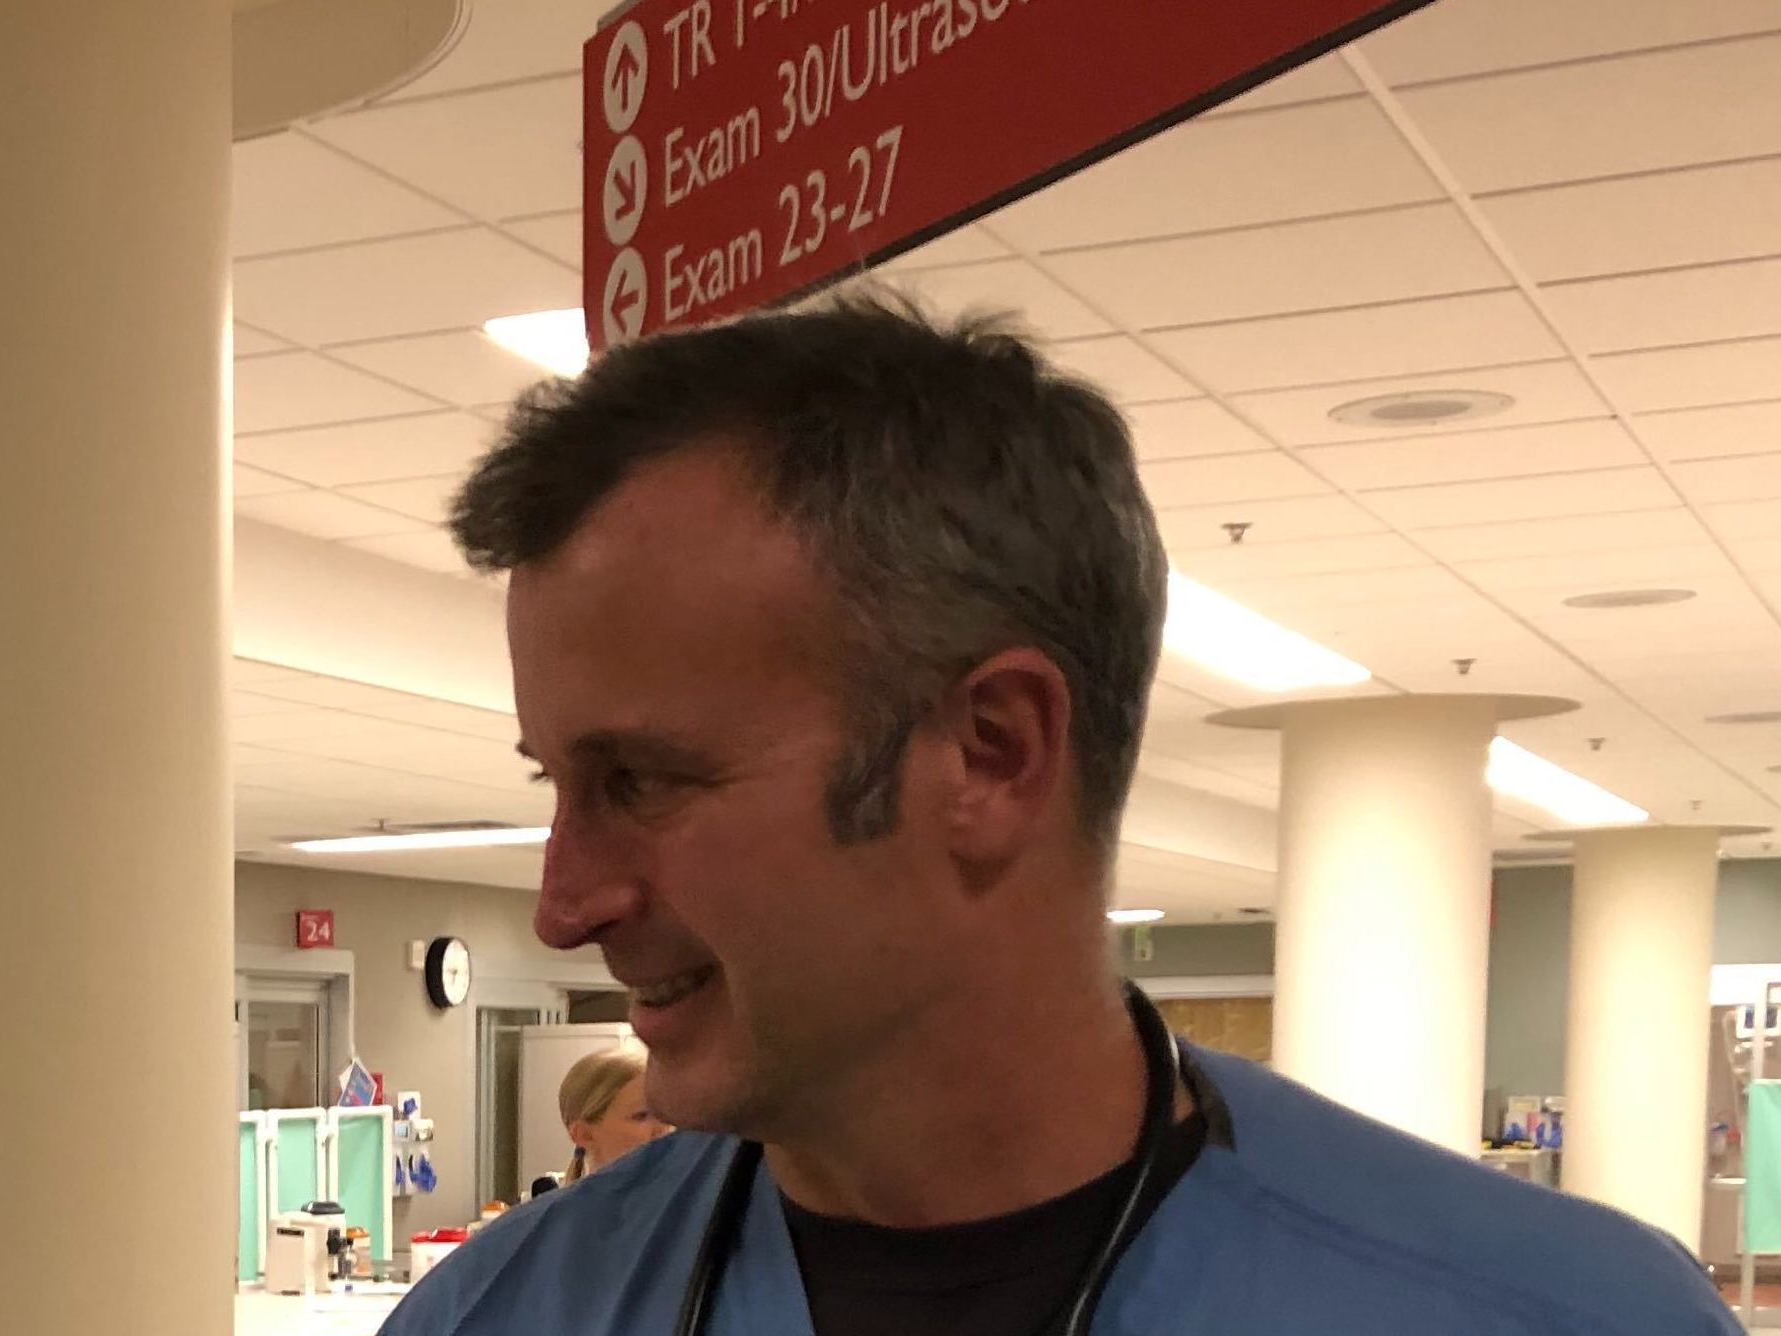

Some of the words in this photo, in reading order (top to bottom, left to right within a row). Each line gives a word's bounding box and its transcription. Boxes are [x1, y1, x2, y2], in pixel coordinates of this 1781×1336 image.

[664, 0, 716, 90] TR
[665, 106, 761, 208] Exam
[665, 228, 763, 322] Exam
[779, 125, 904, 266] 23-27
[306, 919, 332, 942] 24
